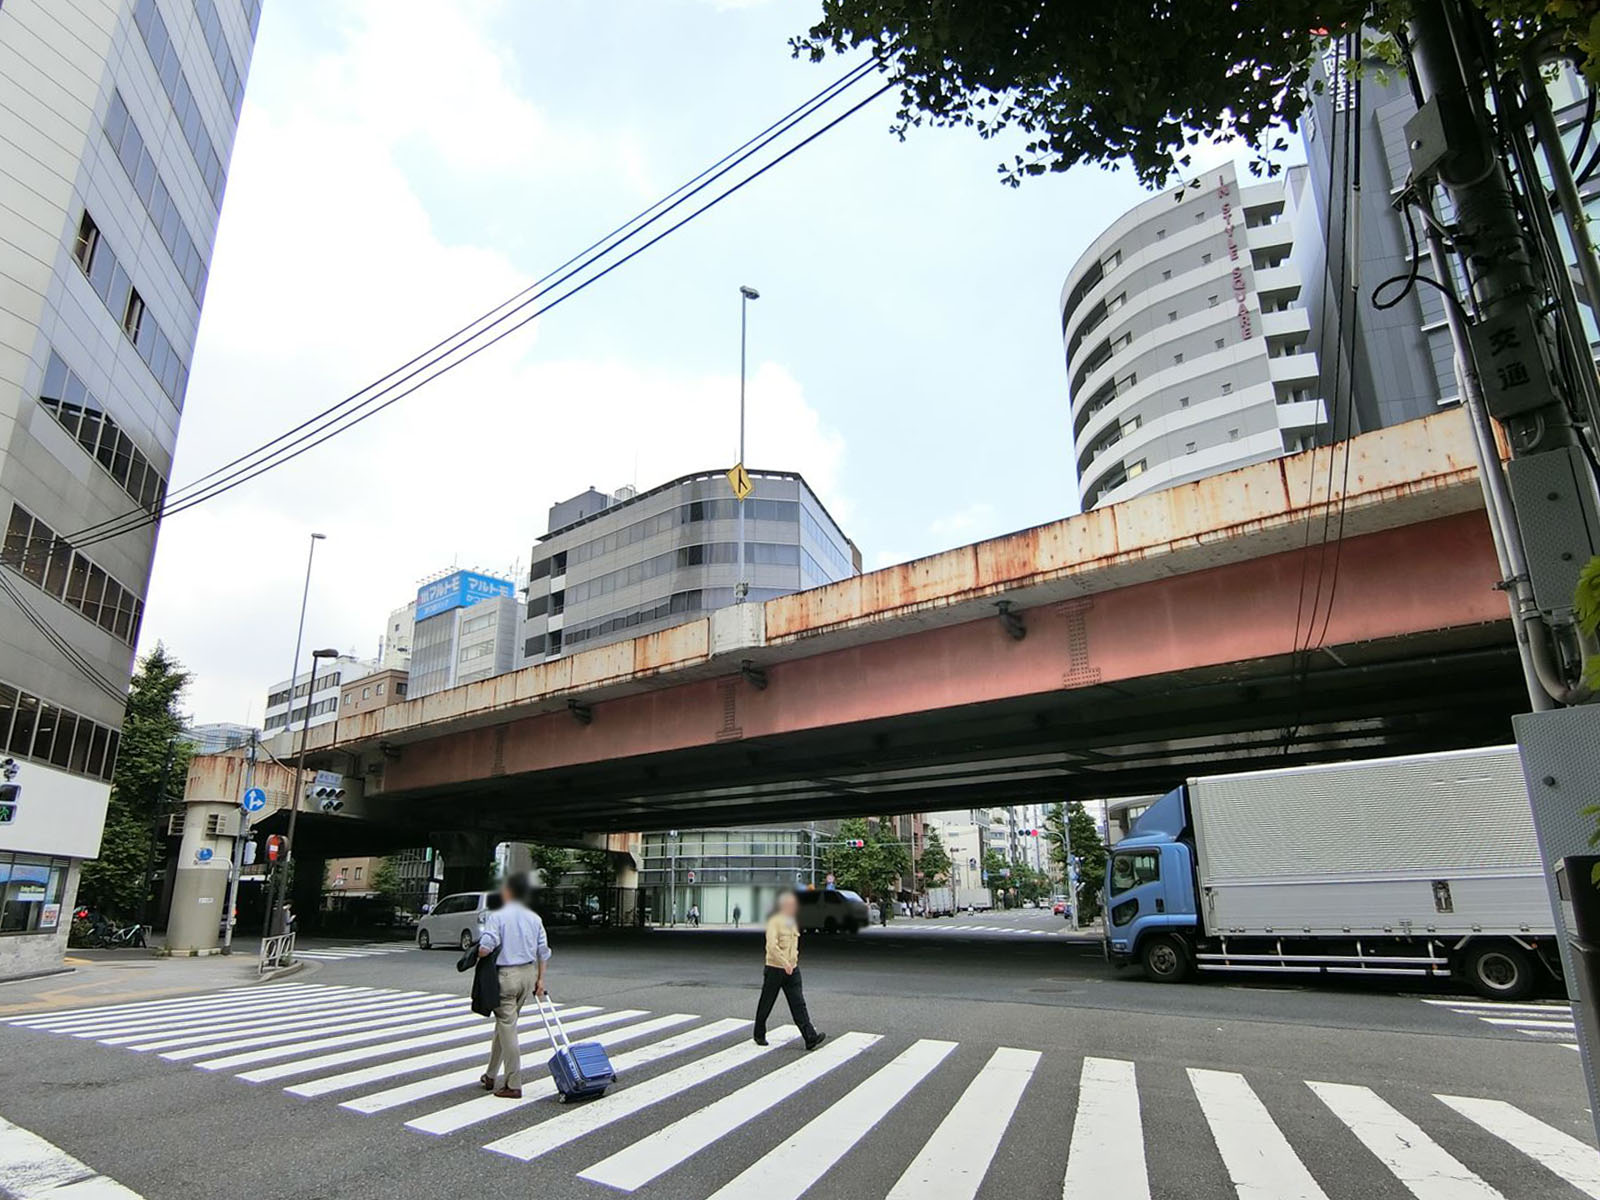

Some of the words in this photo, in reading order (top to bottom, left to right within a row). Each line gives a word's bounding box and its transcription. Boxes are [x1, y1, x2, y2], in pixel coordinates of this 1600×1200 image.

[1232, 267, 1253, 341] SQUARE
[1487, 325, 1531, 392] 交通
[467, 576, 510, 597] マルトモ
